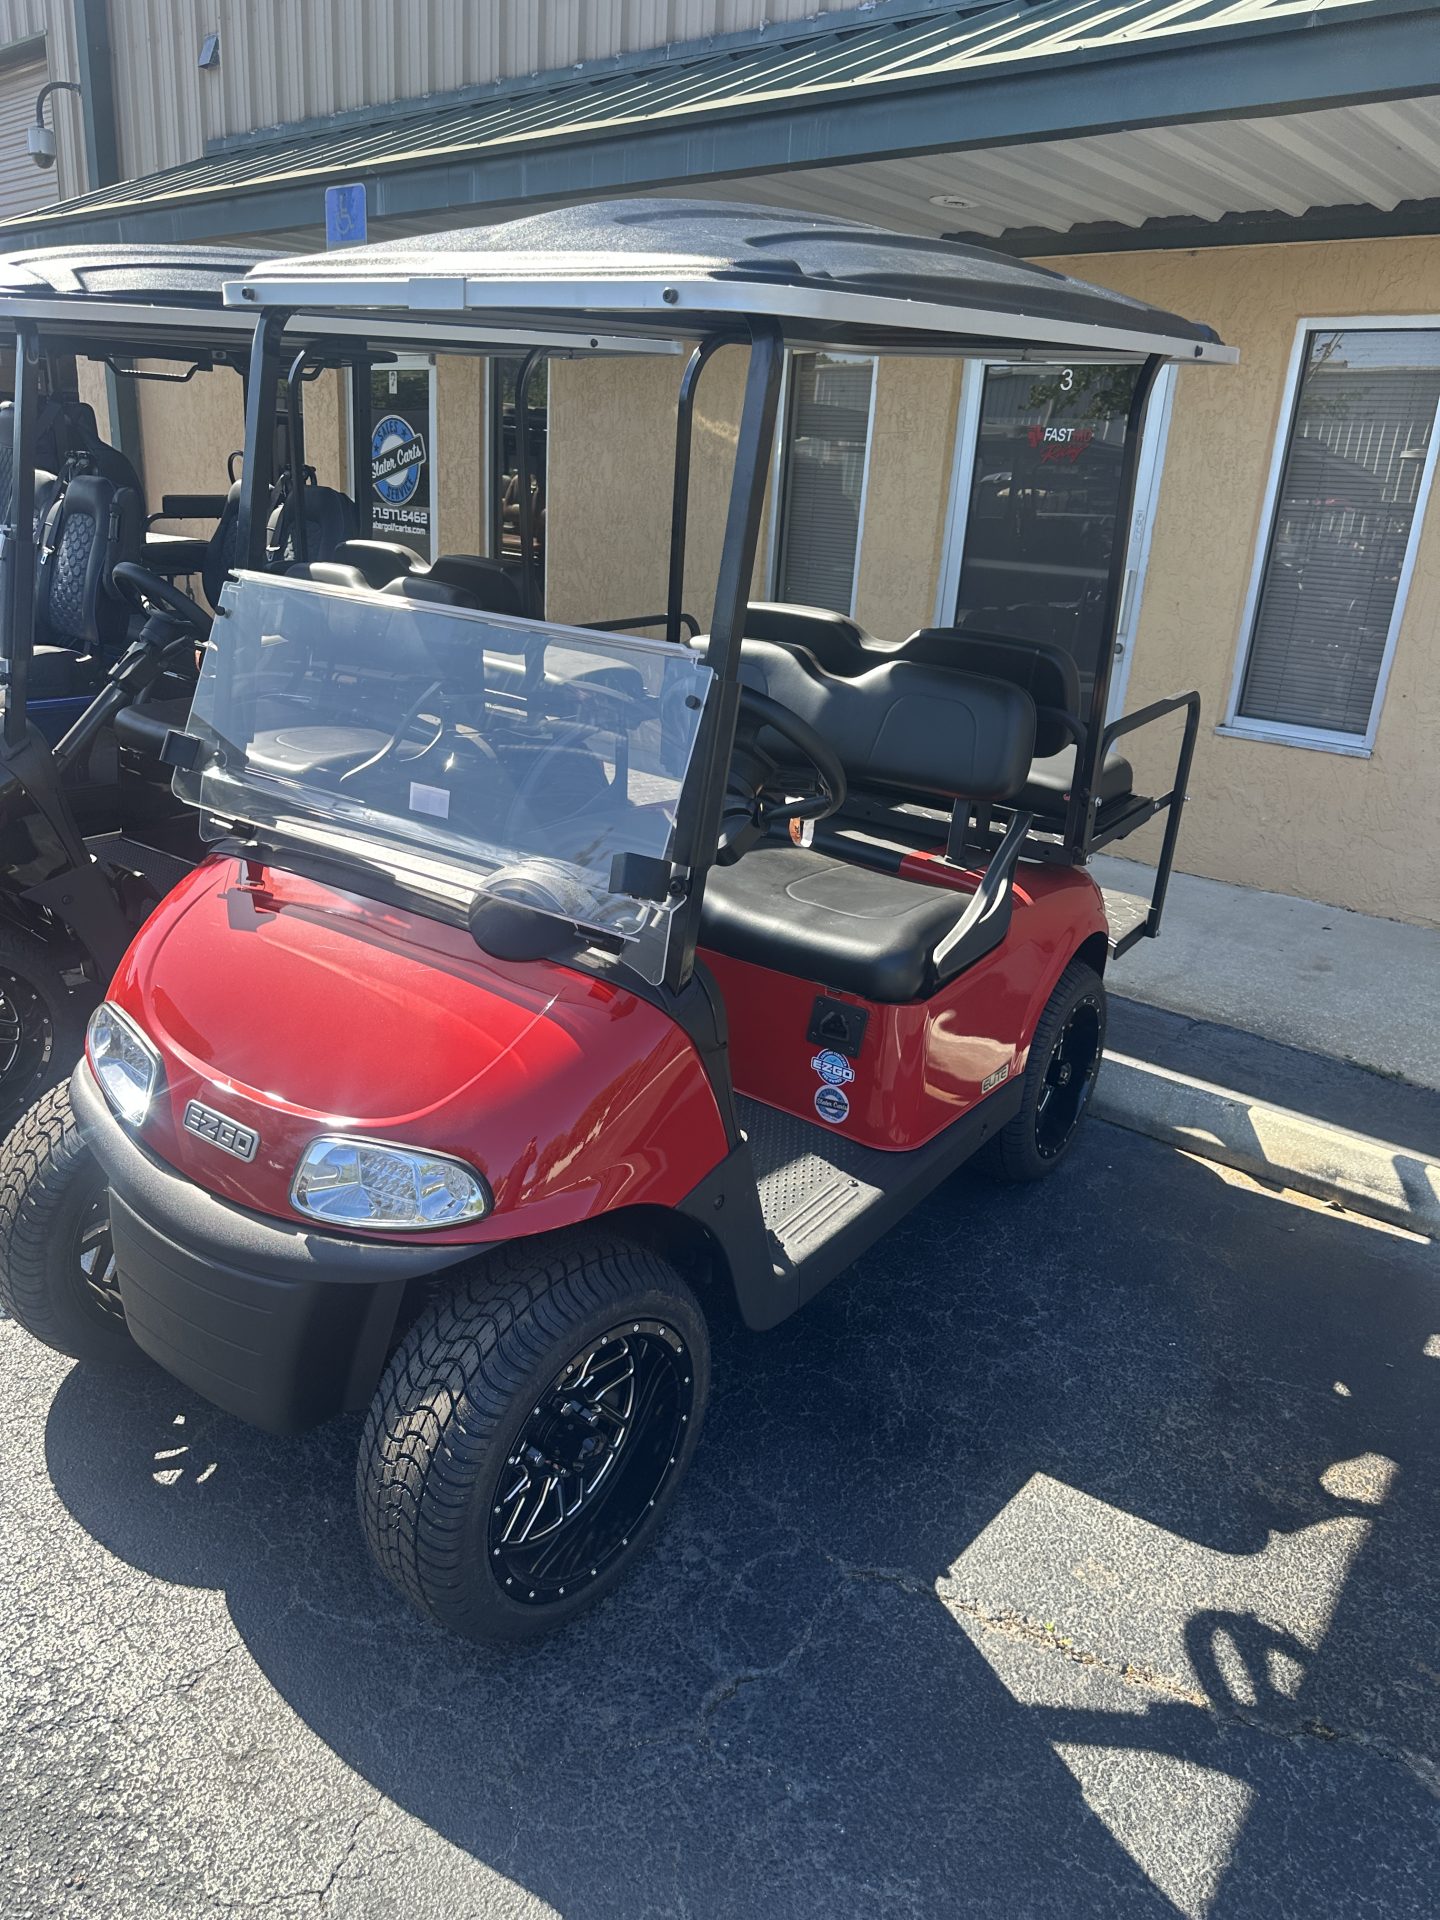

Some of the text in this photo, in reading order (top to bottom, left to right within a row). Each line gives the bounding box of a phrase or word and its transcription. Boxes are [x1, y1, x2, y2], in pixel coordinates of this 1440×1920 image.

[1060, 368, 1074, 391] 3
[378, 420, 399, 441] SALES
[1043, 427, 1075, 442] FAST
[397, 444, 422, 466] Carts
[387, 478, 415, 500] SERVICE
